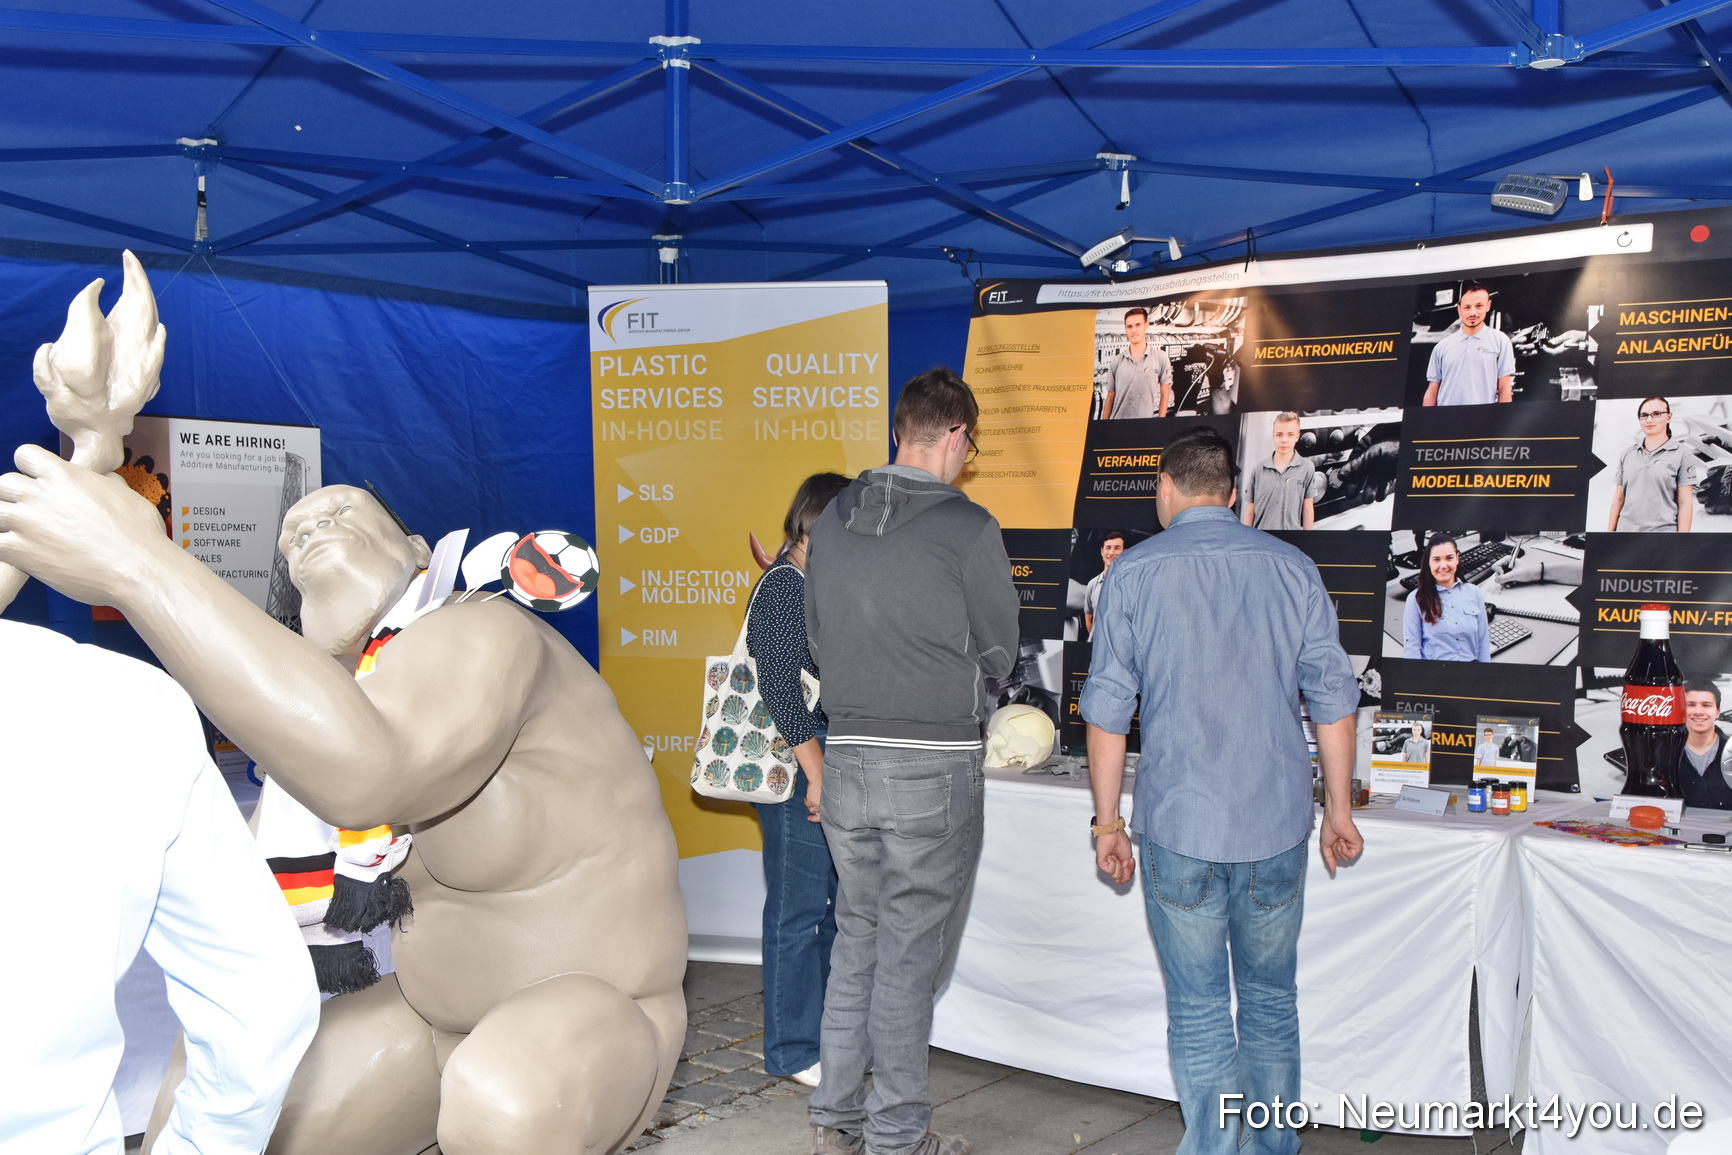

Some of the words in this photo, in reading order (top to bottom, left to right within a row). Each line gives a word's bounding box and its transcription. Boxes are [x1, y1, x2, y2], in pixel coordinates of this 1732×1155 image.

[1058, 271, 1240, 298] https://fit.technology/ausbildungsstellen
[989, 290, 1008, 302] FIT
[627, 312, 659, 329] FIT
[1619, 306, 1732, 326] MASCHINEN-
[977, 344, 1040, 354] AUSBILDUNGSSTELLEN
[1254, 340, 1394, 359] MECHATRONIKER/IN
[600, 353, 707, 377] PLASTIC
[766, 352, 880, 377] QUALITY
[974, 363, 1024, 374] SCHNUPPERLEHRE
[752, 386, 880, 408] SERVICES
[1032, 384, 1088, 393] PRAXISSEMESTER
[600, 386, 723, 410] SERVICES
[1012, 405, 1067, 414] MASTERARBEITEN
[601, 419, 723, 441] IN-HOUSE
[754, 419, 880, 440] IN-HOUSE
[180, 432, 200, 445] WE
[205, 434, 231, 447] ARE
[236, 436, 286, 450] HIRING!
[180, 450, 194, 458] Are
[196, 451, 211, 459] you
[213, 450, 241, 462] looking
[244, 452, 255, 461] for
[264, 454, 277, 463] job
[279, 455, 286, 463] in
[1415, 446, 1530, 461] TECHNISCHE/R
[180, 460, 213, 469] Additive
[216, 461, 272, 473] Manufacturing
[961, 470, 1036, 479] BETRIEBSBESICHTIGUNGEN
[1412, 474, 1550, 489] MODELLBAUER/IN
[638, 484, 674, 501] SLS
[193, 507, 225, 515] DESIGN
[193, 523, 257, 531] DEVELOPMENT
[640, 527, 679, 544] GDP
[193, 539, 241, 547] SOFTWARE
[194, 554, 222, 562] SALES
[641, 570, 750, 587] INJECTION
[1600, 578, 1699, 594] INDUSTRIE-
[642, 587, 736, 604] MOLDING
[642, 629, 678, 646] RIM
